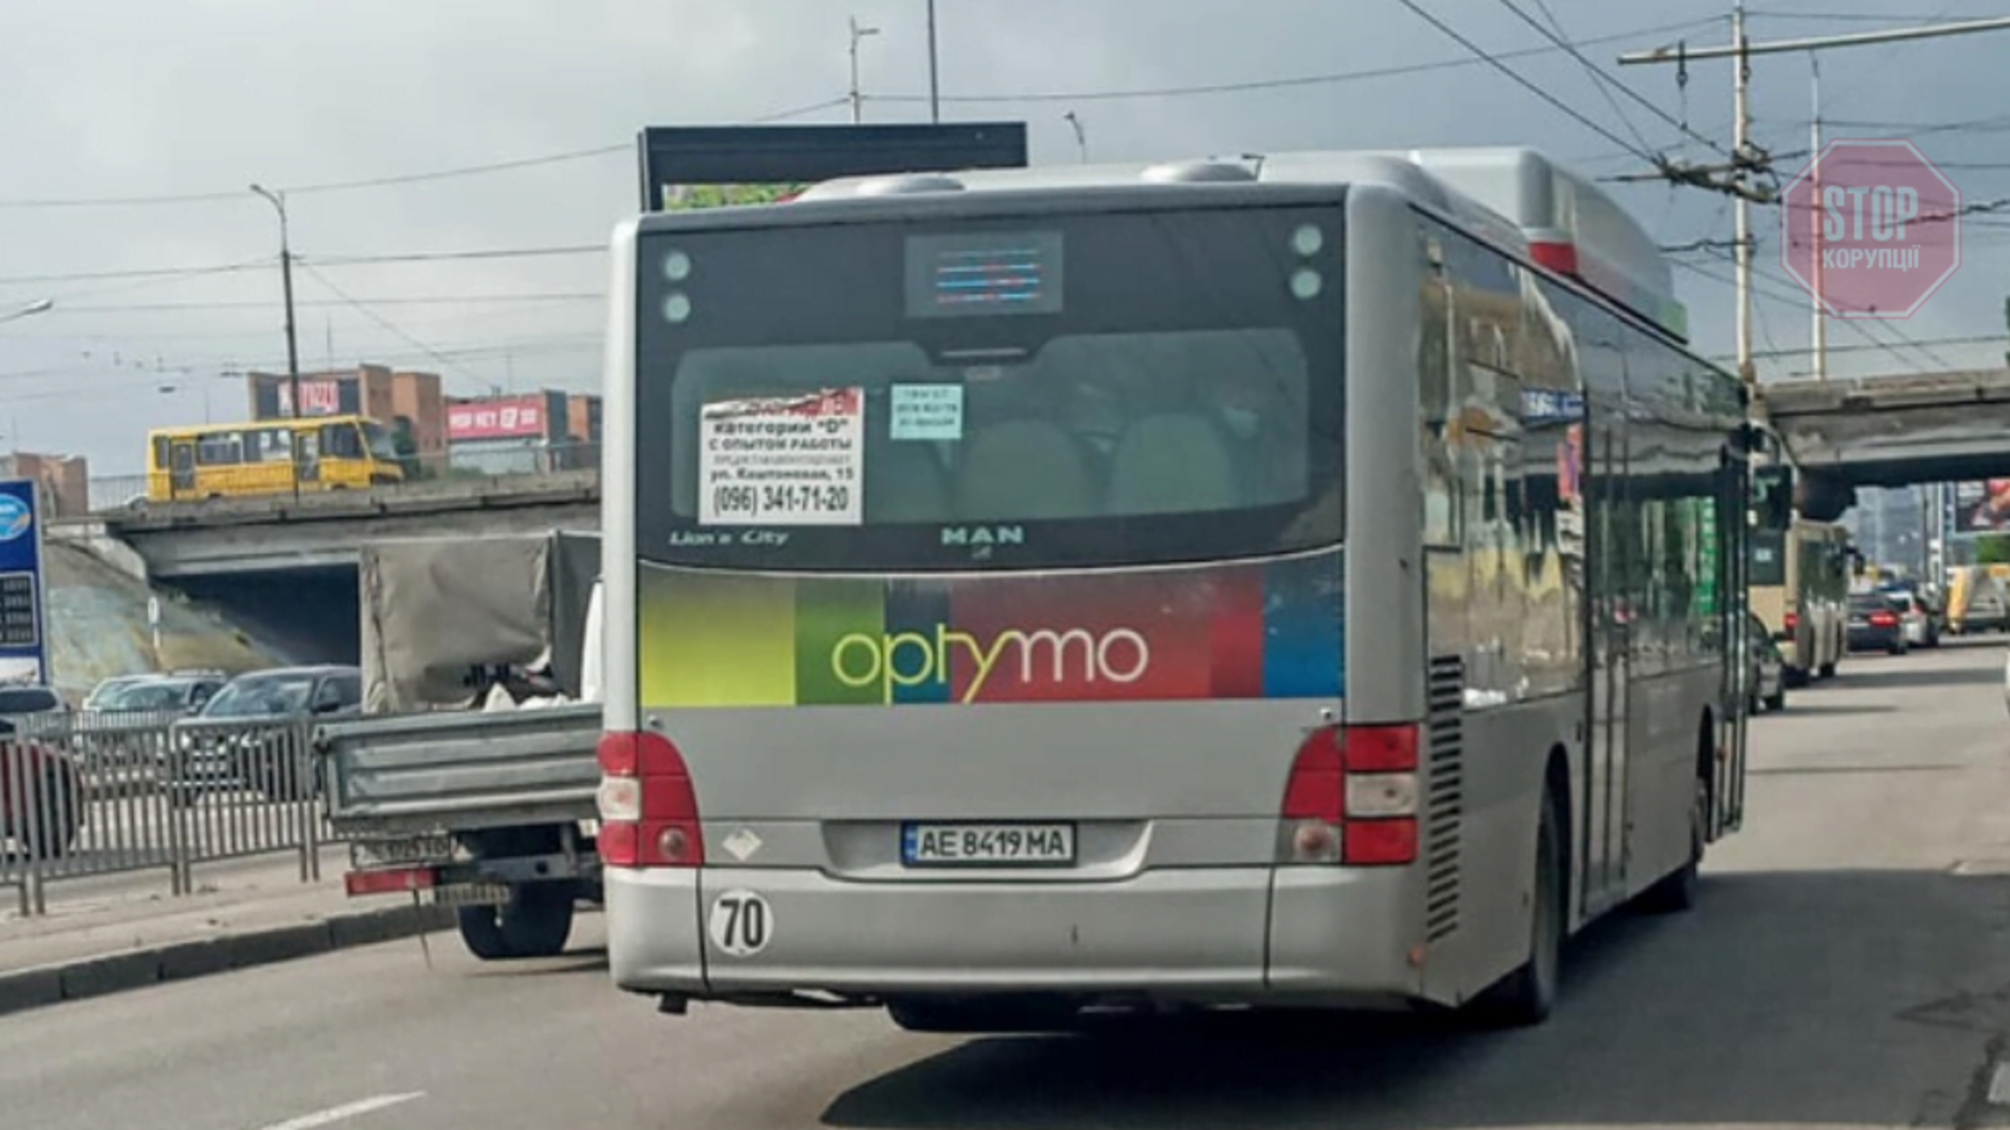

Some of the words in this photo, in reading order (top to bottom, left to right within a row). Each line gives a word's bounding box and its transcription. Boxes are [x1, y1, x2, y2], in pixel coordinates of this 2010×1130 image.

[721, 437, 787, 451] ОПЫТОМ
[790, 437, 852, 451] РАБОТЫ
[714, 485, 758, 517] (096)
[763, 486, 848, 512] 341-71-20
[740, 529, 789, 549] City
[941, 526, 1023, 546] MAN
[831, 623, 1149, 706] optymo
[720, 898, 764, 948] 70
